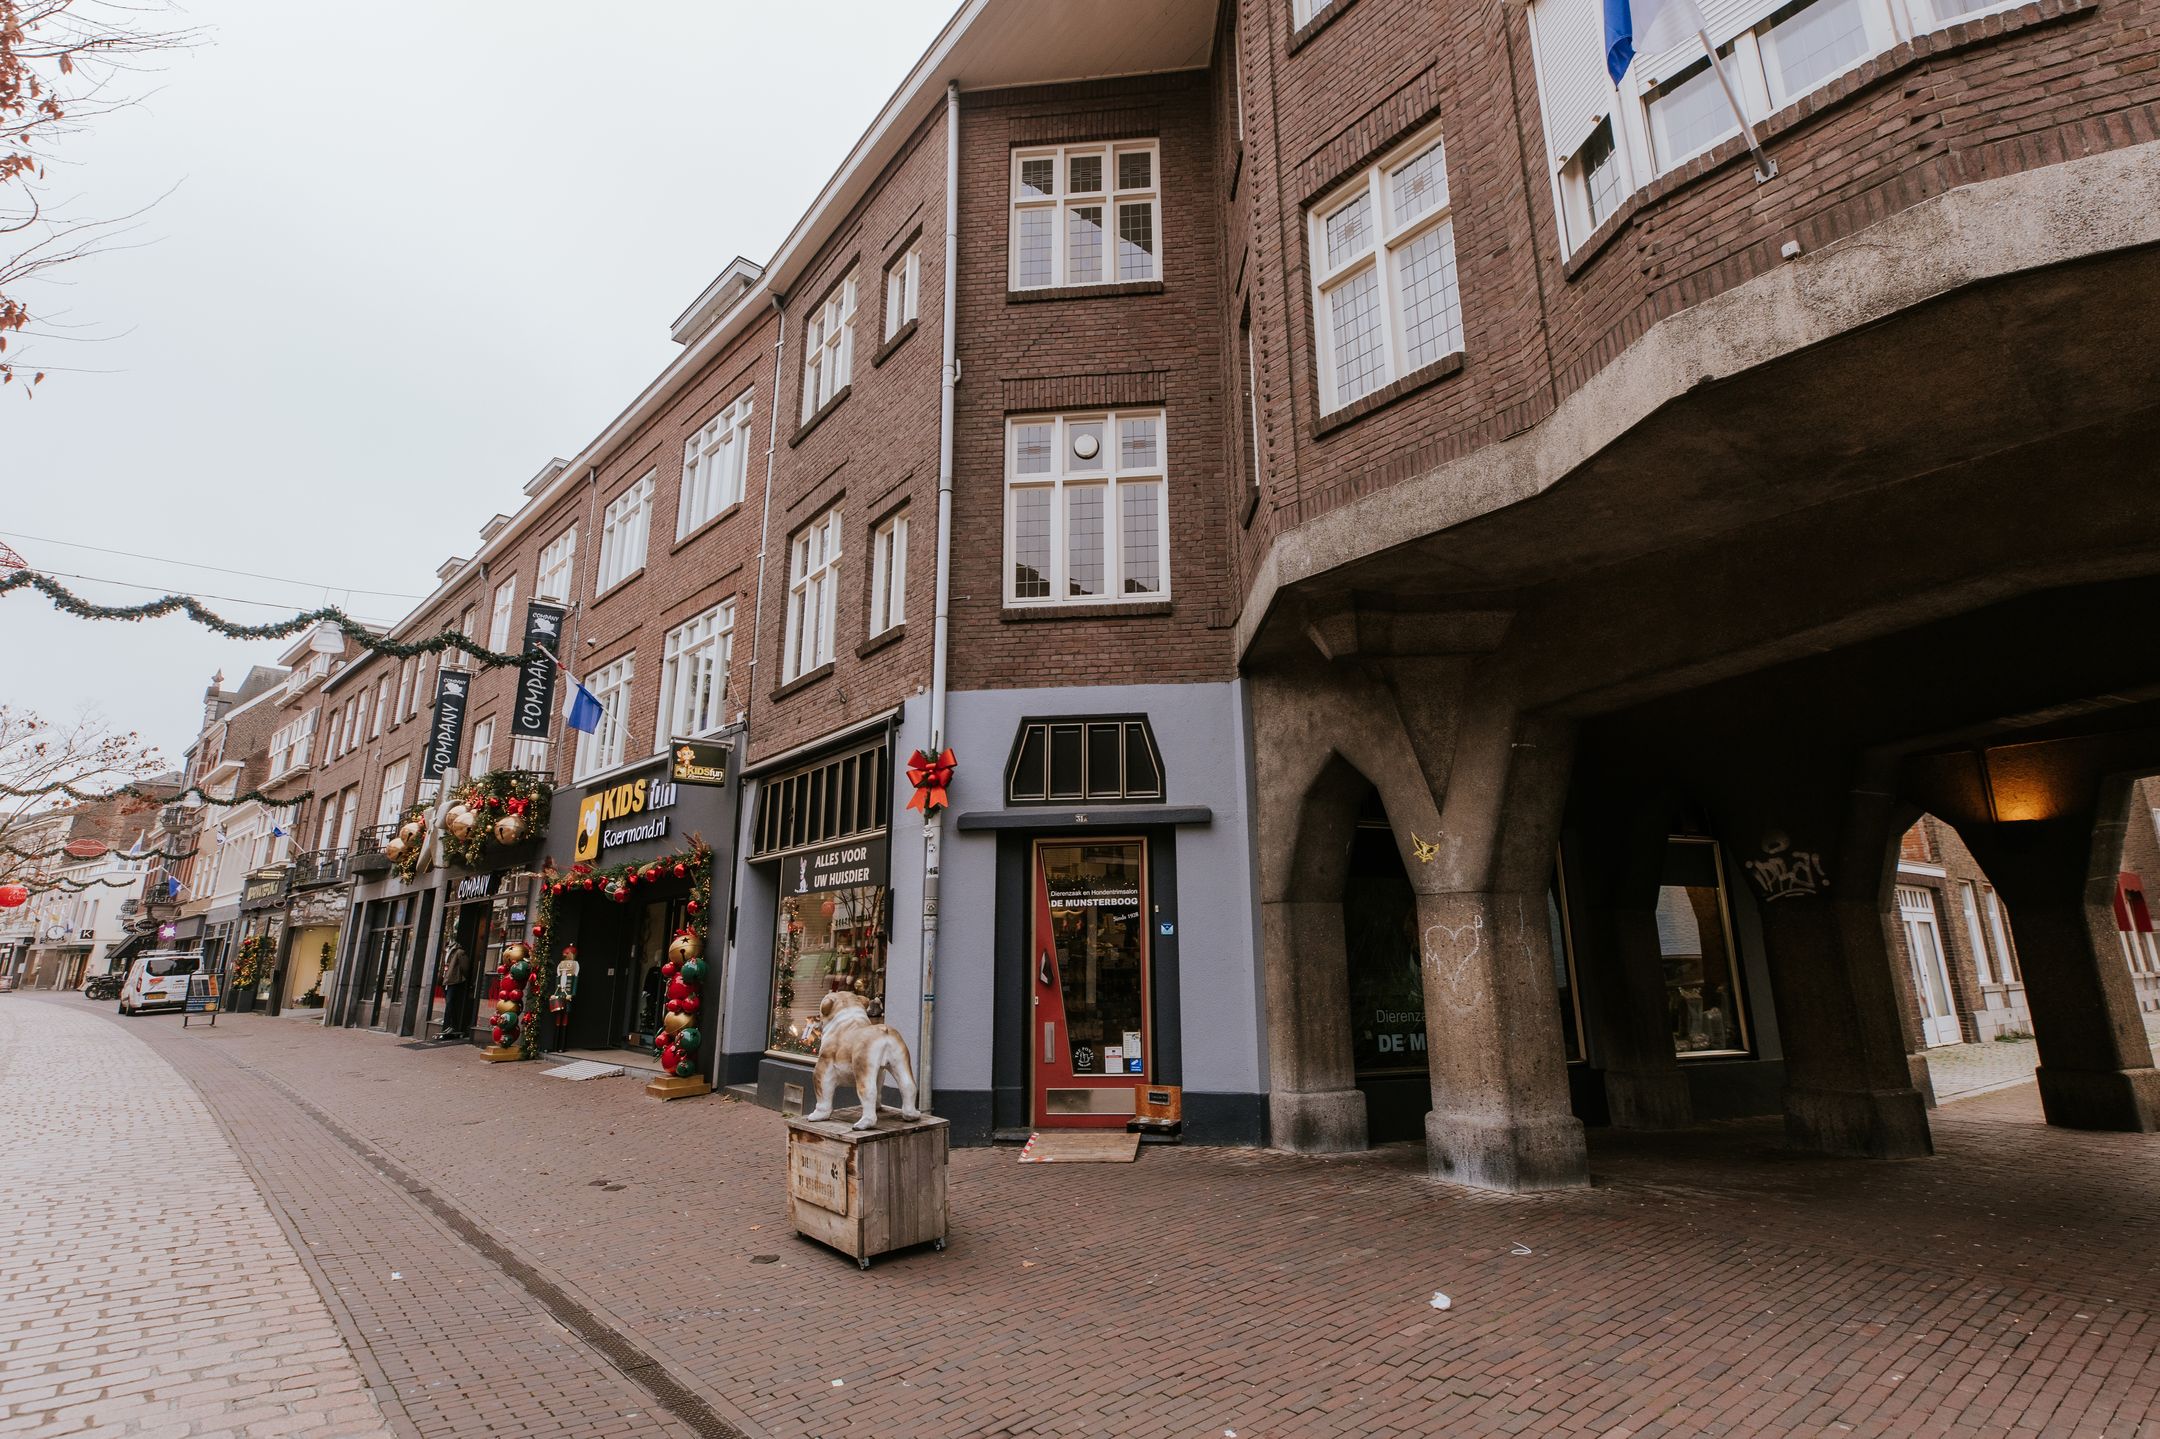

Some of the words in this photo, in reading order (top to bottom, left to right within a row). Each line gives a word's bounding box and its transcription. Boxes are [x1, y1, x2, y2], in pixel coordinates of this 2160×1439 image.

[532, 612, 559, 621] COMPANY
[433, 703, 459, 774] COMPANY
[601, 779, 646, 821] KIDS
[647, 779, 677, 811] fun
[603, 816, 666, 848] Roermond.nl
[814, 852, 839, 868] ALLES
[841, 847, 867, 864] VOOR
[458, 874, 491, 899] COMPANY
[814, 873, 828, 888] UW
[829, 867, 870, 886] HUISDIER
[1050, 889, 1082, 897] Dierenzaak
[1091, 888, 1138, 896] Hondentrimsalon
[1051, 899, 1063, 908] DE
[1065, 897, 1138, 907] MUNSTERBOOG
[1378, 1033, 1405, 1052] DE
